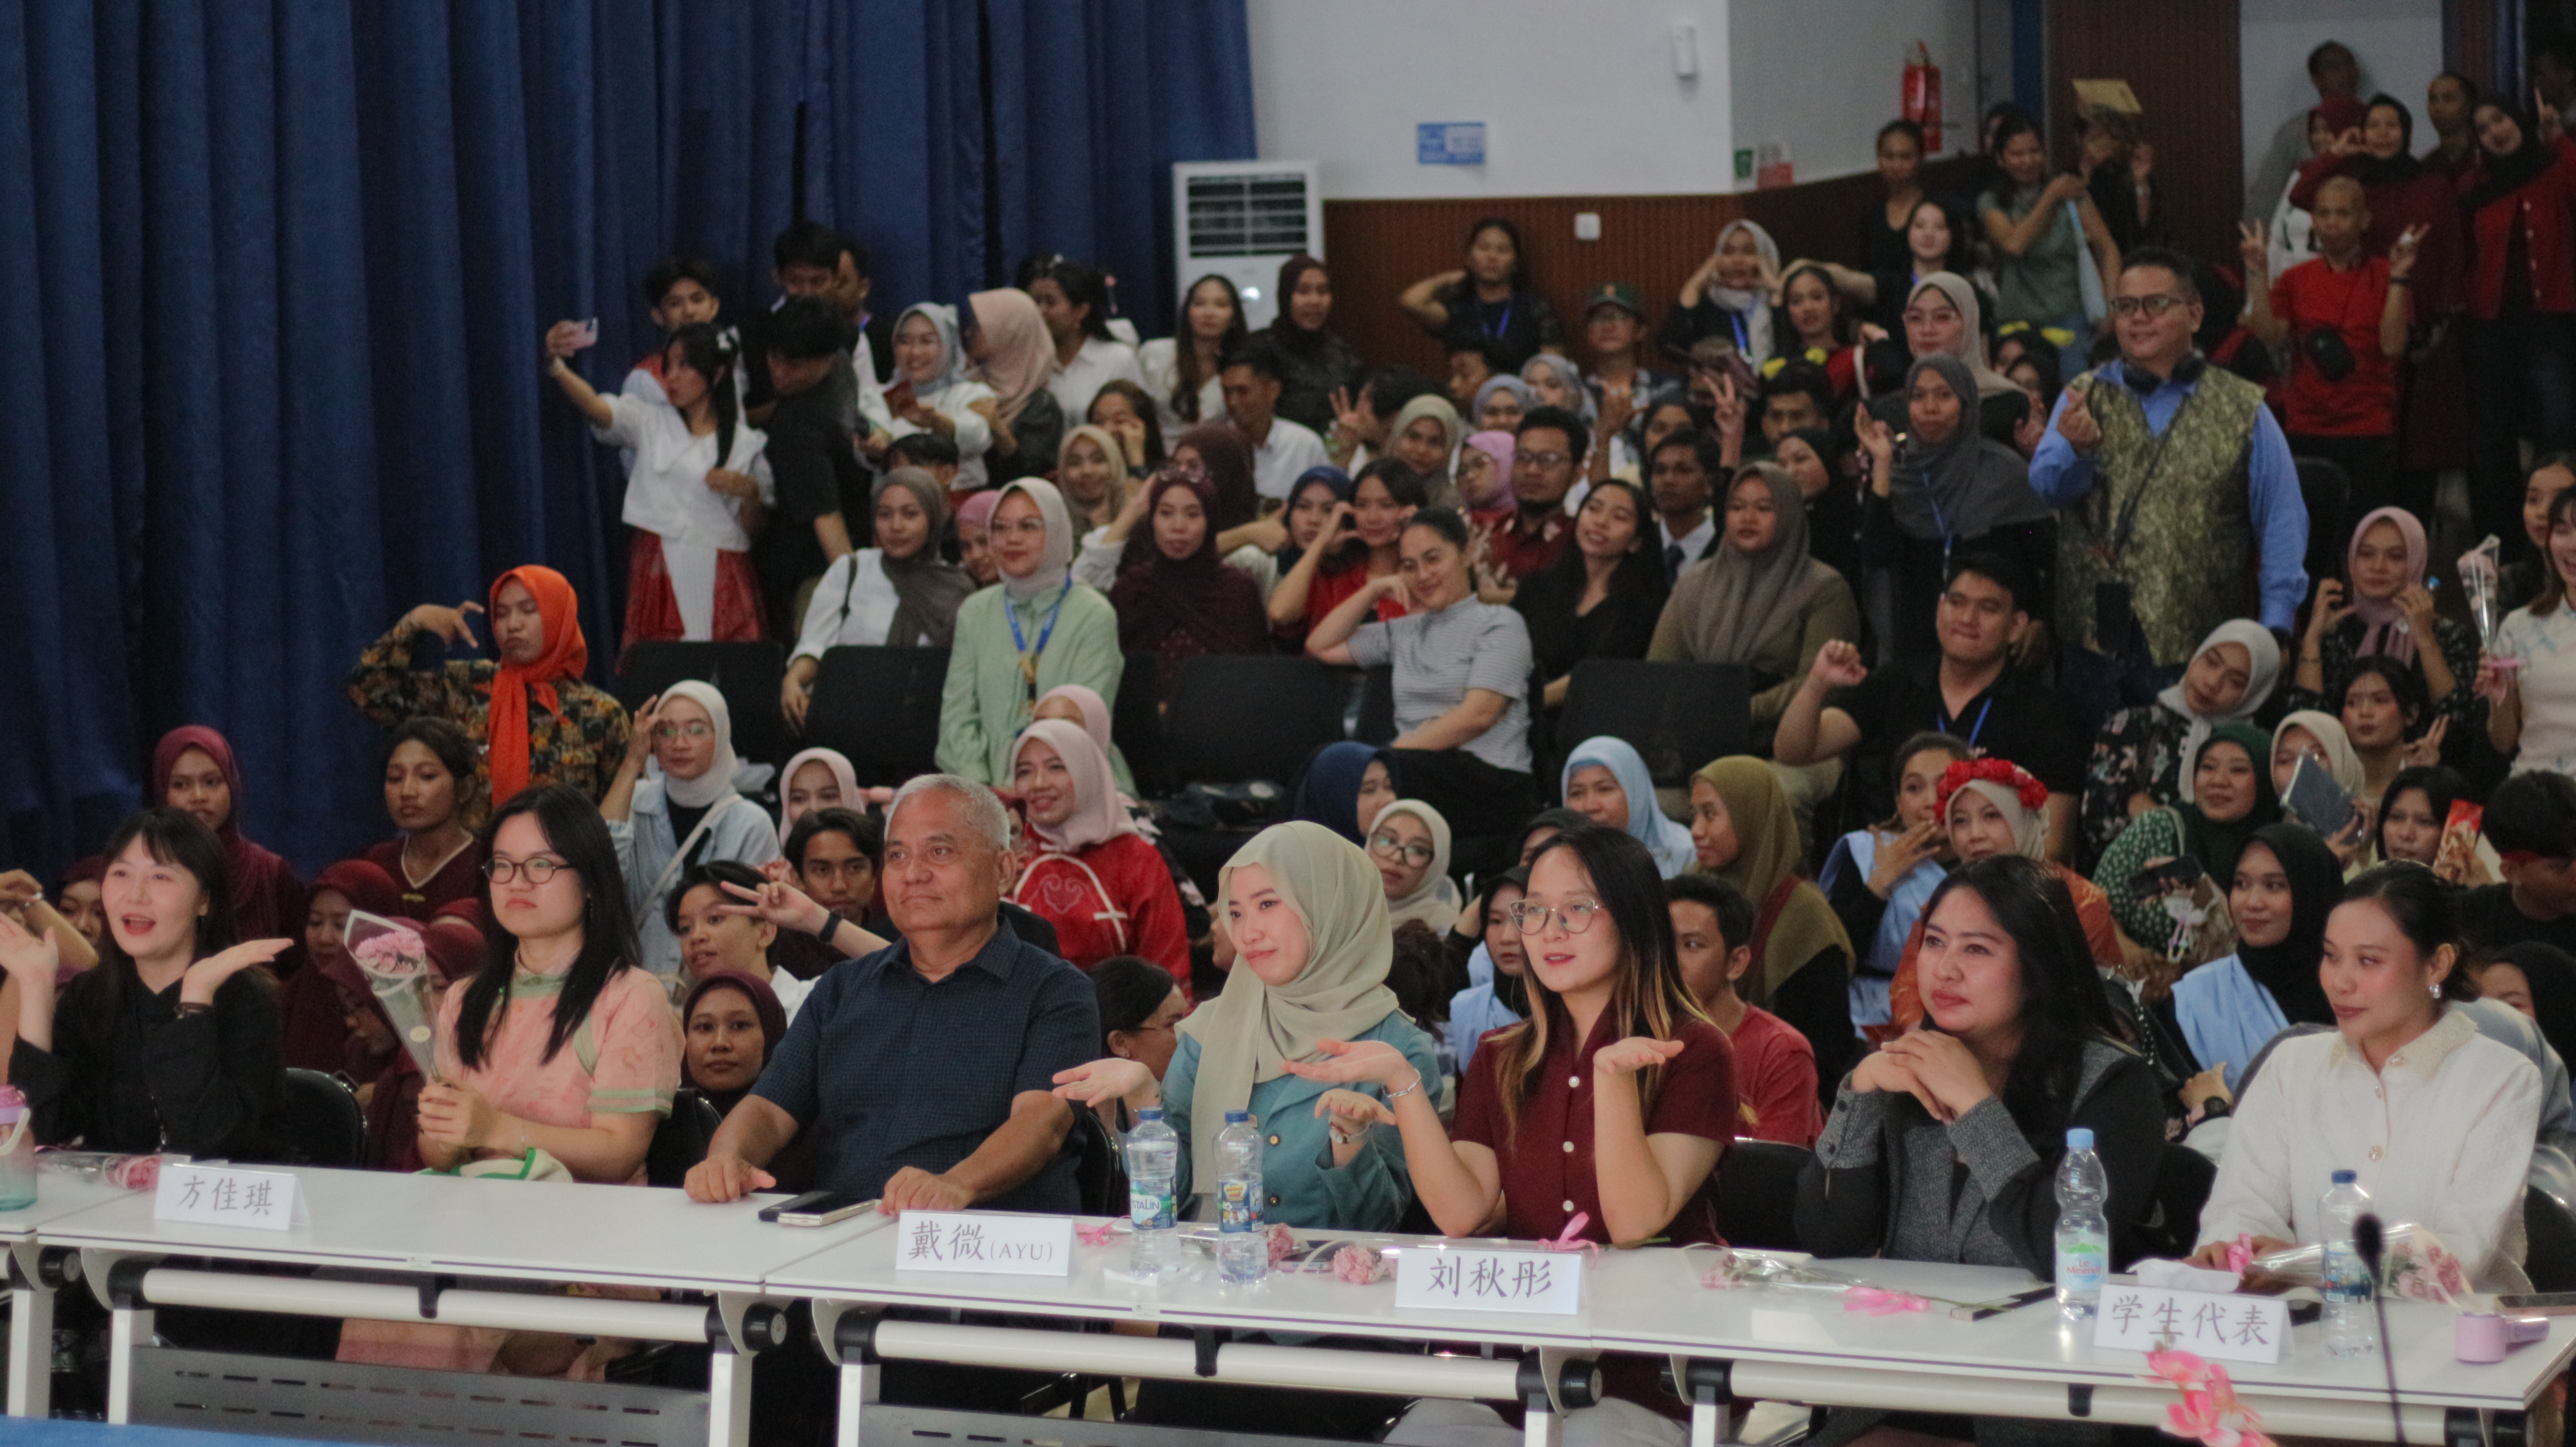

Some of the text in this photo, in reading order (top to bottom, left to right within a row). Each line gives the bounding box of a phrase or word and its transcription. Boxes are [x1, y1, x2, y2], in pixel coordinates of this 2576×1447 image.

[176, 1175, 273, 1216] 方佳琪
[1426, 1255, 1552, 1299] 刘秋彤
[2067, 1266, 2101, 1275] Minerale
[2079, 1258, 2090, 1268] Le
[2112, 1294, 2270, 1346] 学生代表
